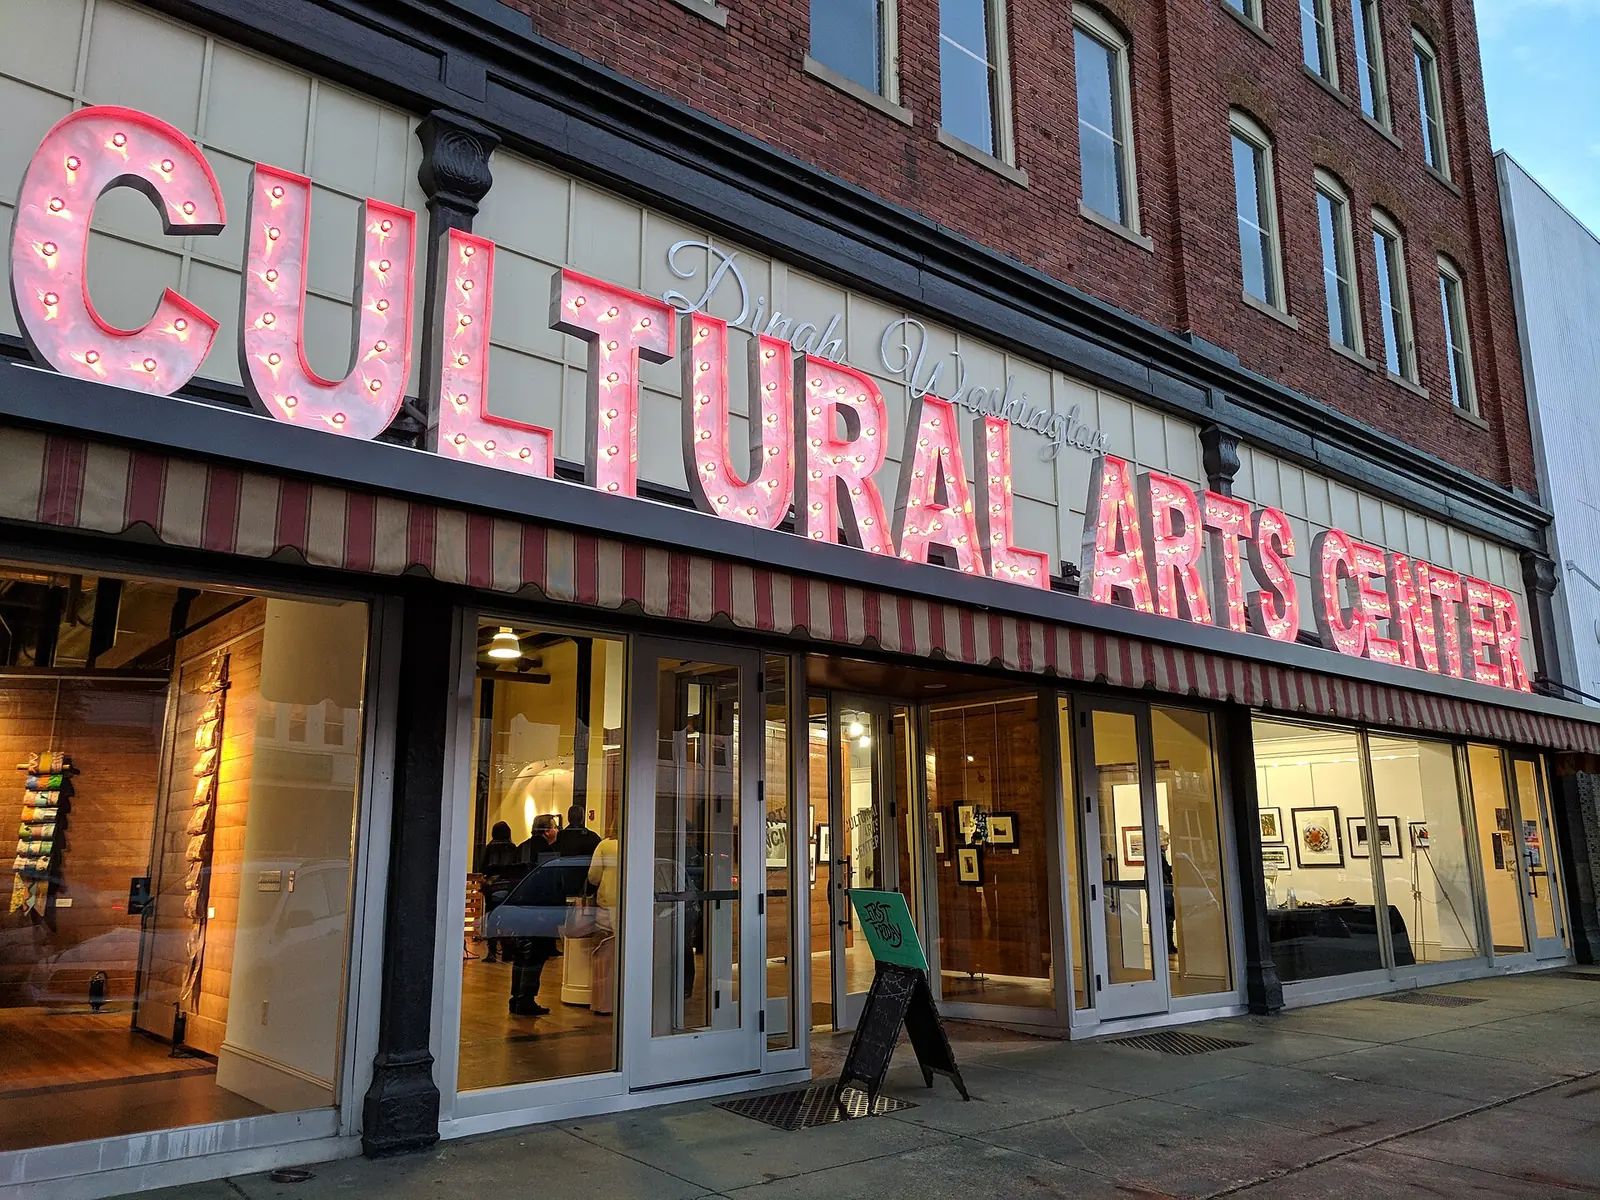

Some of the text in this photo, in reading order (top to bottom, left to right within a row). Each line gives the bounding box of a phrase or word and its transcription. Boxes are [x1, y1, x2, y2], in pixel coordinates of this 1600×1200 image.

[11, 104, 1531, 694] CULTURAL ARTS CENTER
[662, 240, 1112, 462] Dinah Washington
